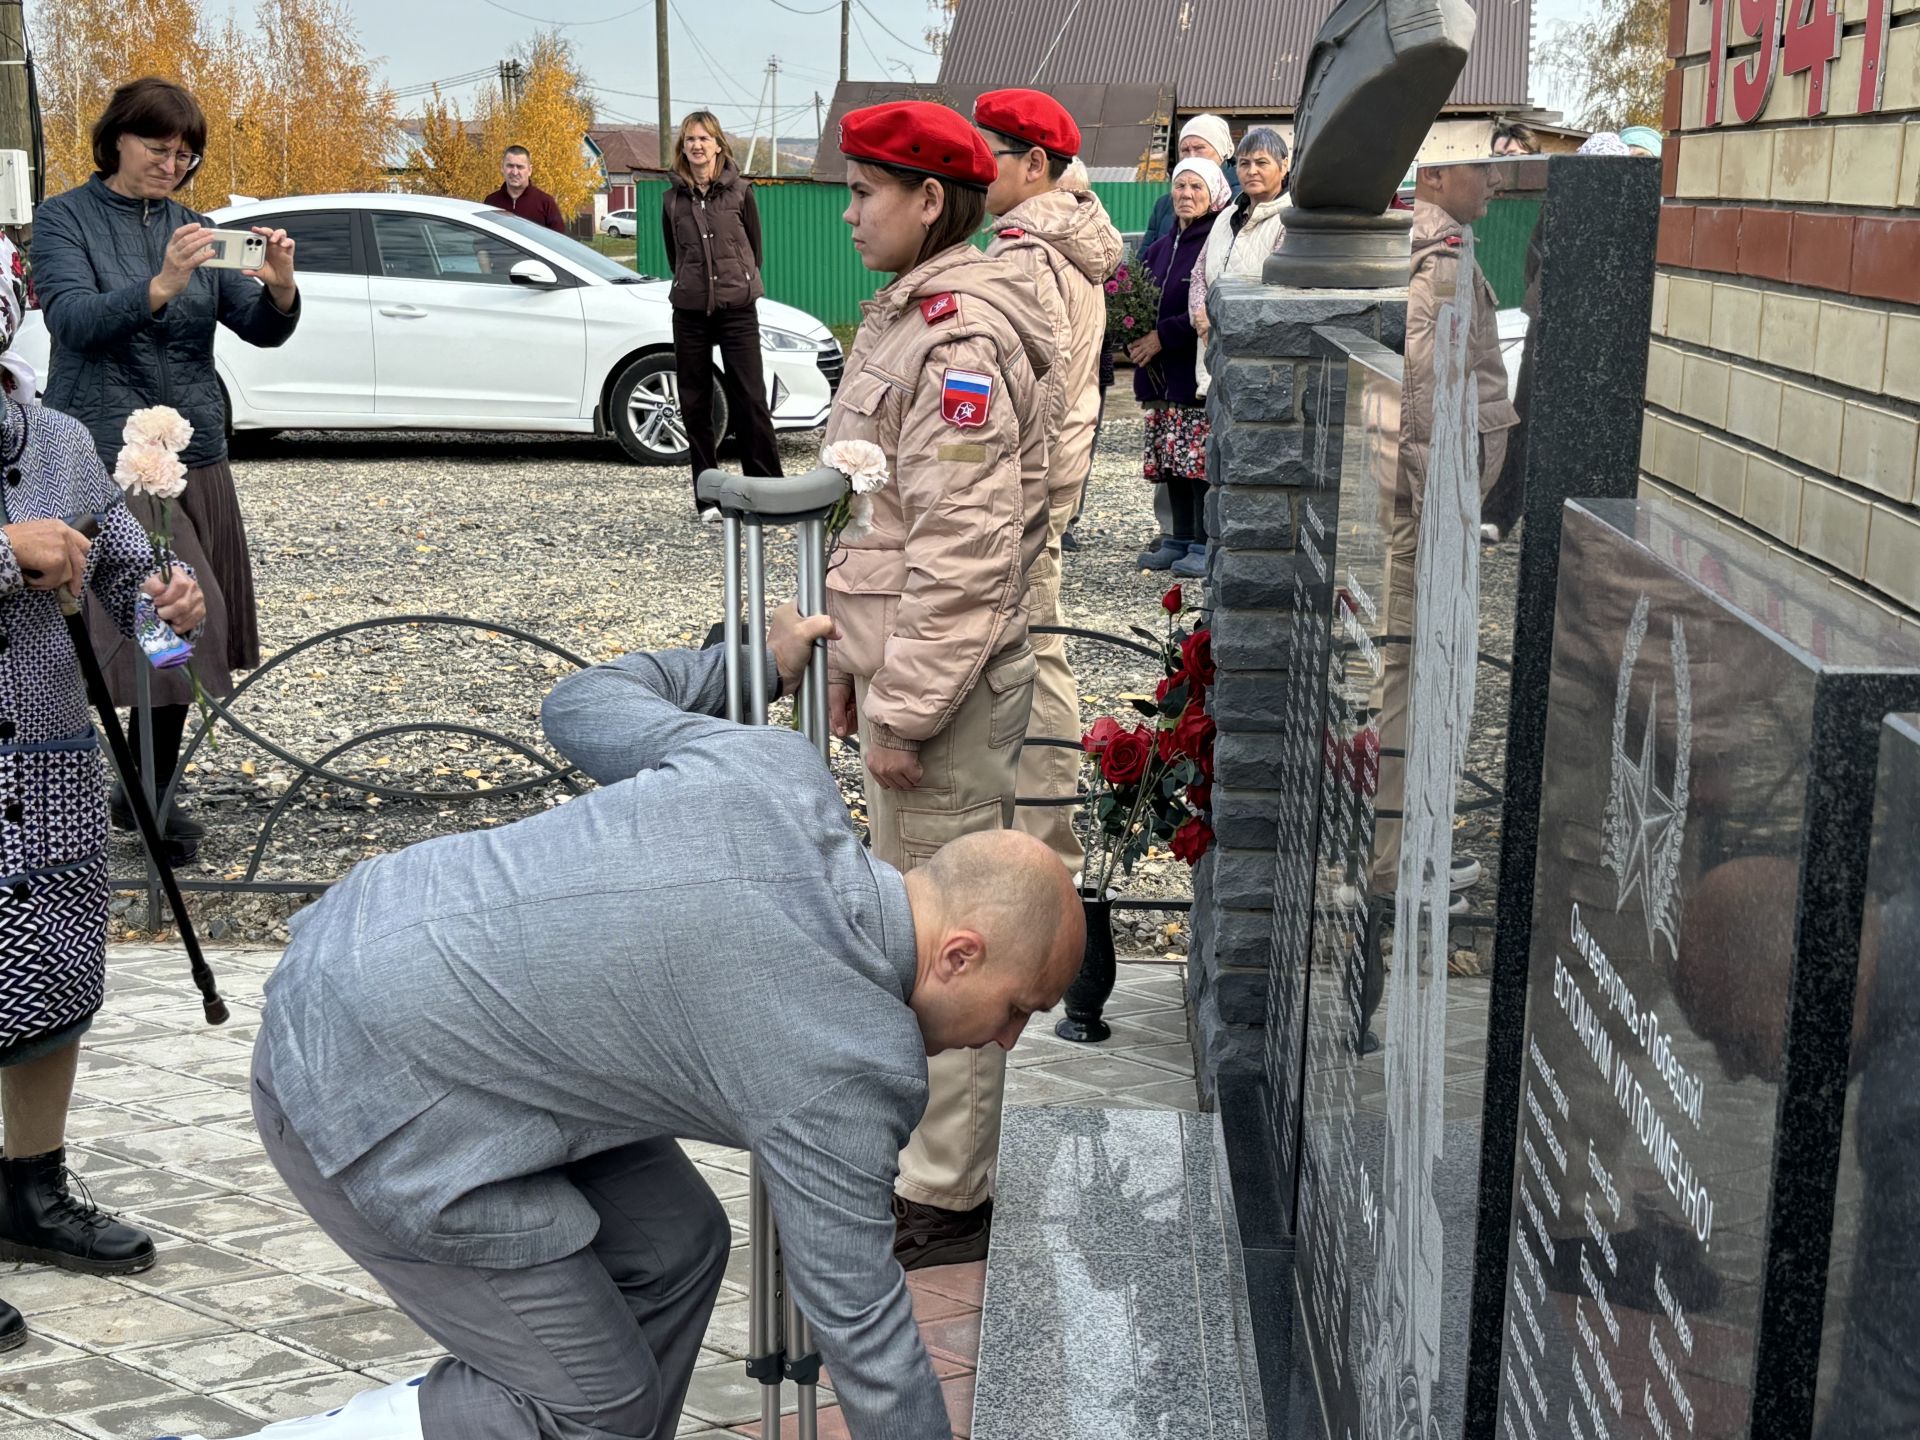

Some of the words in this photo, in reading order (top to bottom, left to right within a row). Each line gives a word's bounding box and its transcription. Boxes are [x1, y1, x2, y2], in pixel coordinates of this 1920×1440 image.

[1704, 0, 1891, 127] 1941
[1570, 902, 1588, 961] Они
[1588, 937, 1637, 1036] вернулись
[1639, 1008, 1647, 1051] с
[1647, 1009, 1703, 1131] Победой!
[1553, 954, 1611, 1084] ВСПОМНИМ
[1614, 1051, 1631, 1118] ИХ
[1631, 1079, 1712, 1252] ПОИМЕННО!
[1360, 1161, 1378, 1256] 1941
[1673, 1299, 1692, 1357] Иван
[1668, 1360, 1694, 1433] Никита
